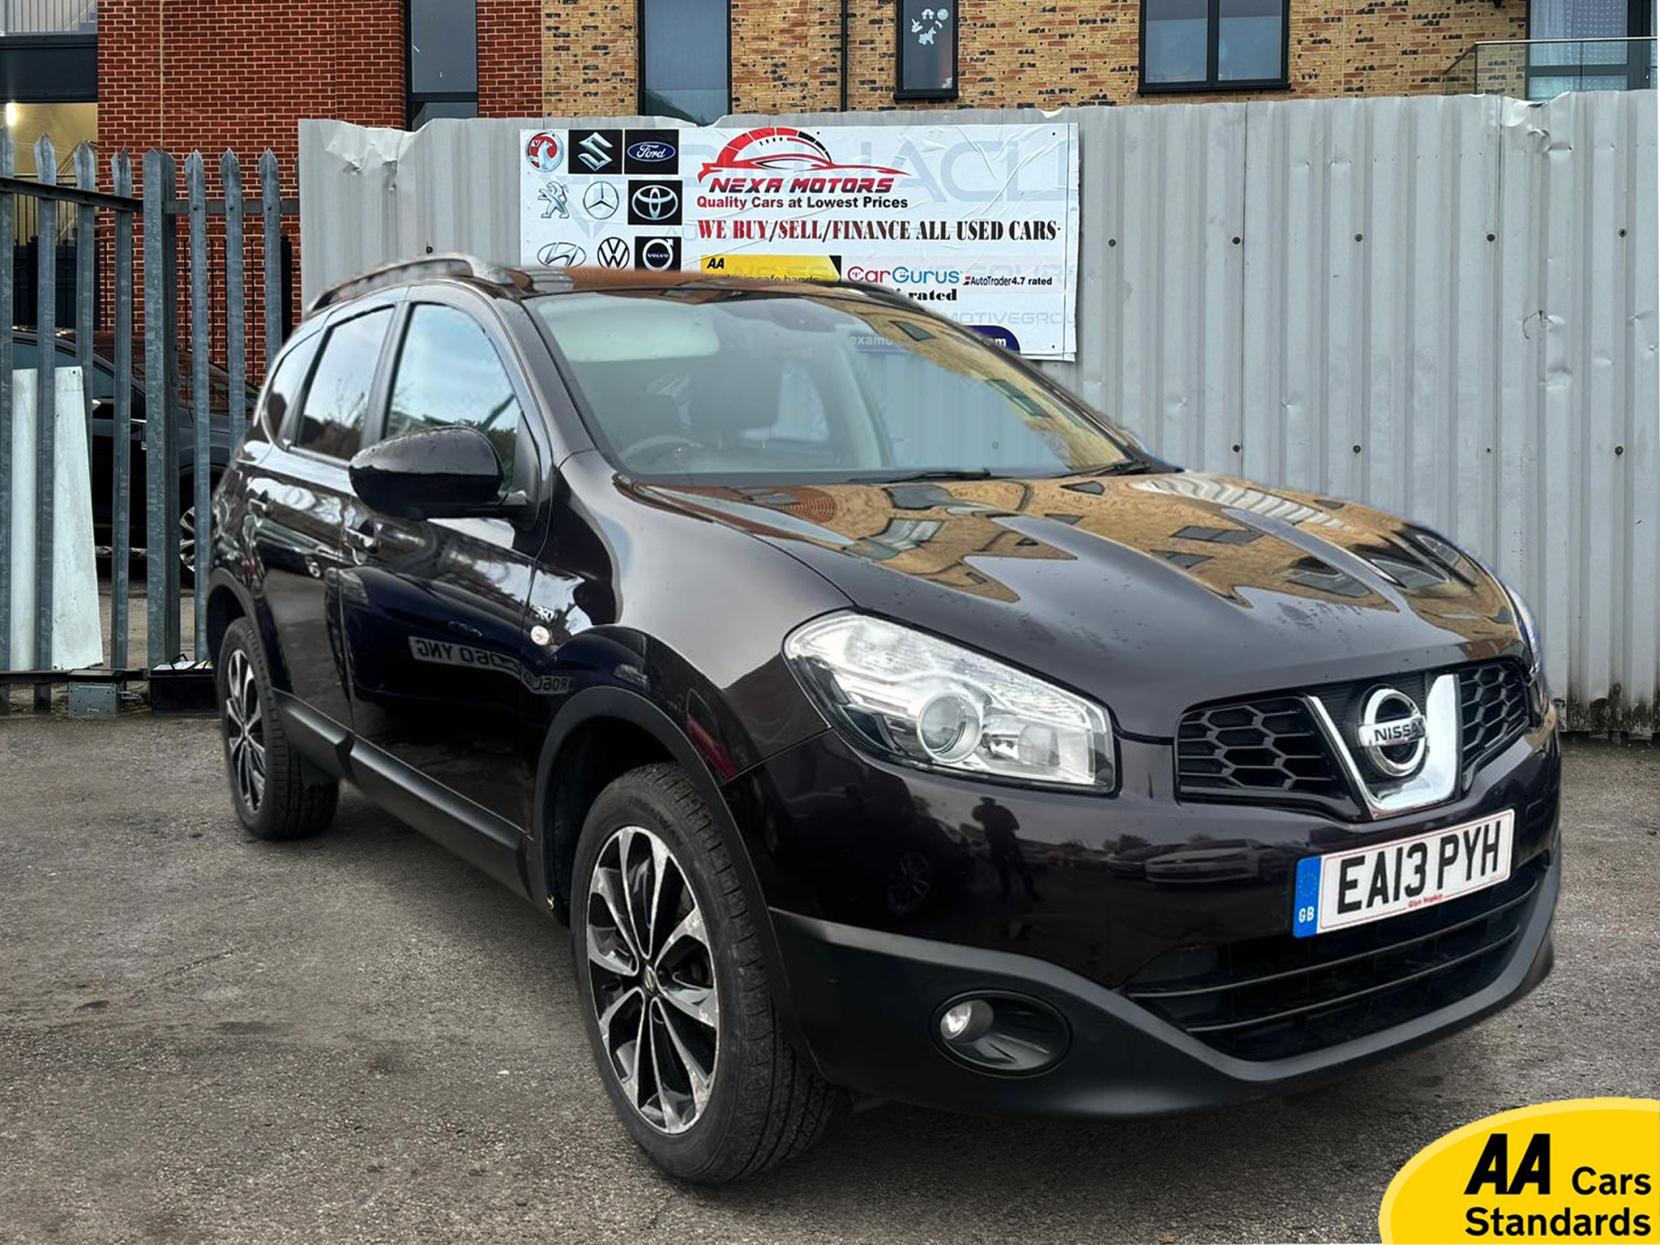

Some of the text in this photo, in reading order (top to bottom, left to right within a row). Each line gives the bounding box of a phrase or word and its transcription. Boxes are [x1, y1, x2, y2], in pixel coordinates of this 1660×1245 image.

[636, 144, 666, 159] Ford
[709, 178, 894, 193] NEXA MOTORS
[697, 196, 908, 210] Quality Cars at Lowest Prices
[697, 220, 727, 239] WE
[733, 219, 911, 242] BUY/SELL/FINANCE
[916, 220, 951, 240] ALL
[956, 220, 1004, 240] USED
[706, 257, 725, 269] AA
[847, 266, 960, 284] CarGurus
[1028, 277, 1053, 286] rated
[908, 288, 957, 301] rated
[1336, 820, 1501, 915] EA13 PYH
[1298, 906, 1315, 923] GB
